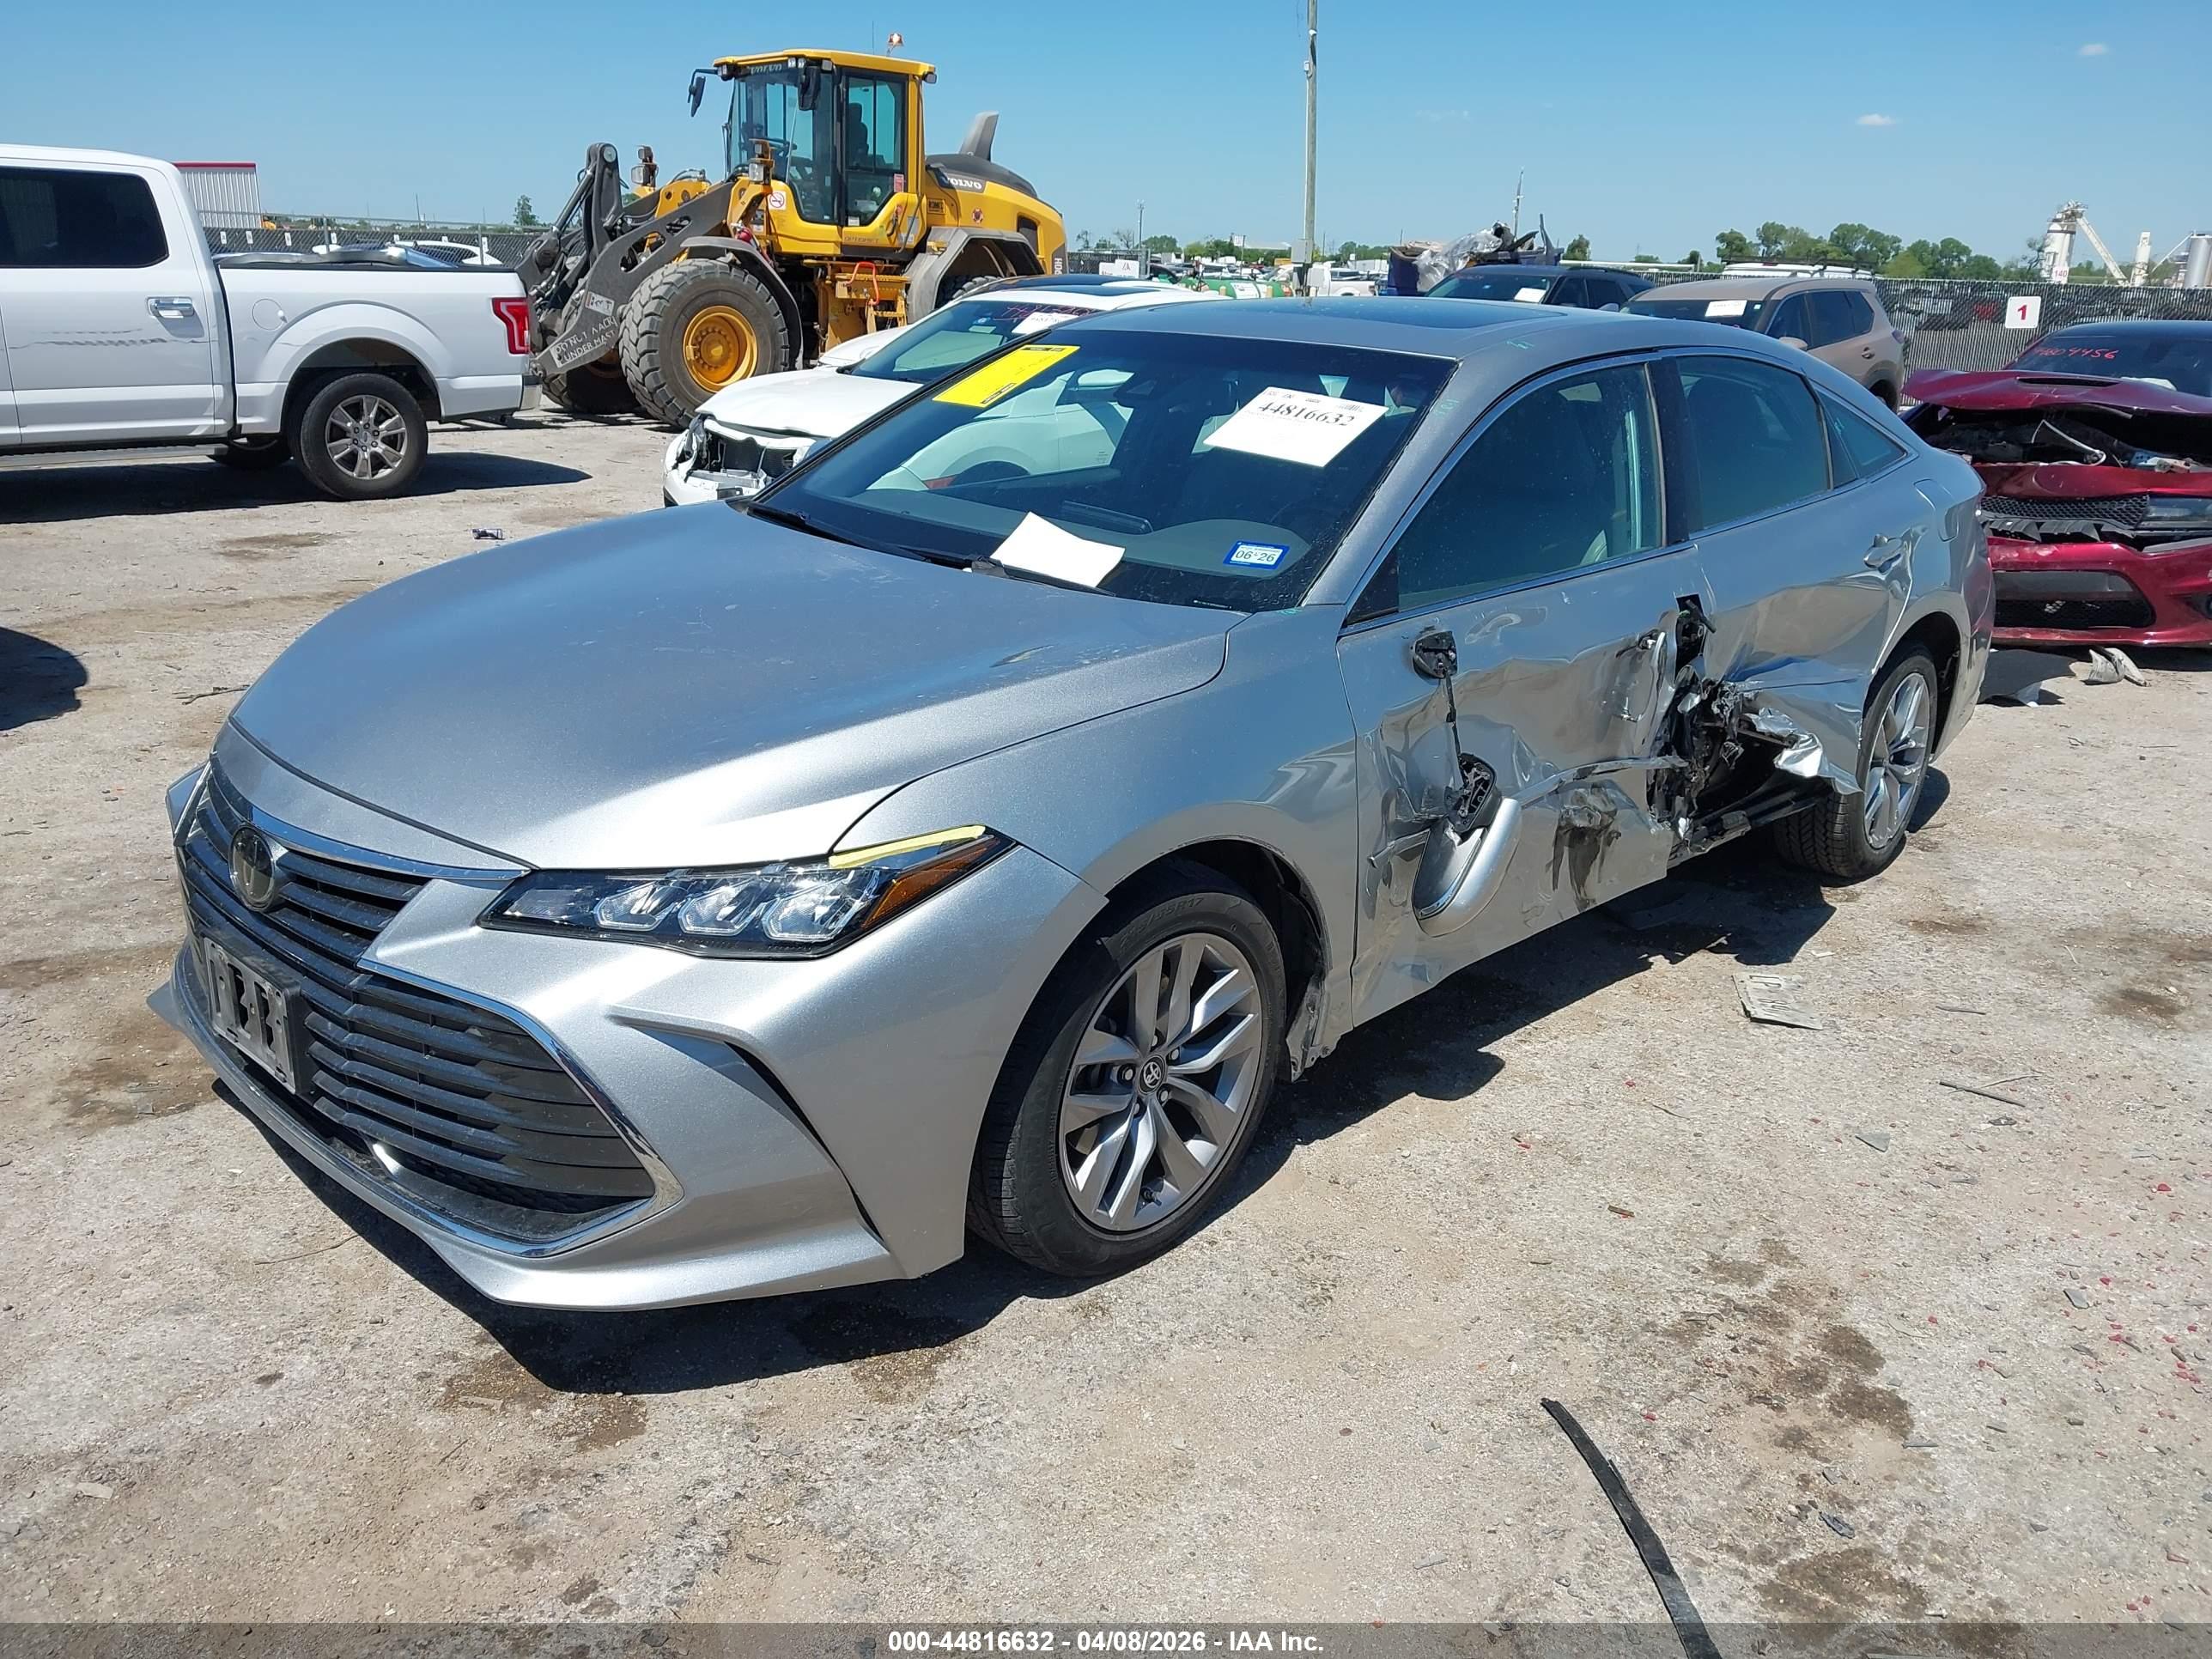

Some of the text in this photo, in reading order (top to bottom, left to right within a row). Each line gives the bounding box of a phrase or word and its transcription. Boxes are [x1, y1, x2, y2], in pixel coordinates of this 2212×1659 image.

[940, 175, 982, 190] VOLVO
[2018, 304, 2028, 320] 1
[563, 330, 616, 362] UNDER MAST
[1259, 401, 1355, 426] 44816632
